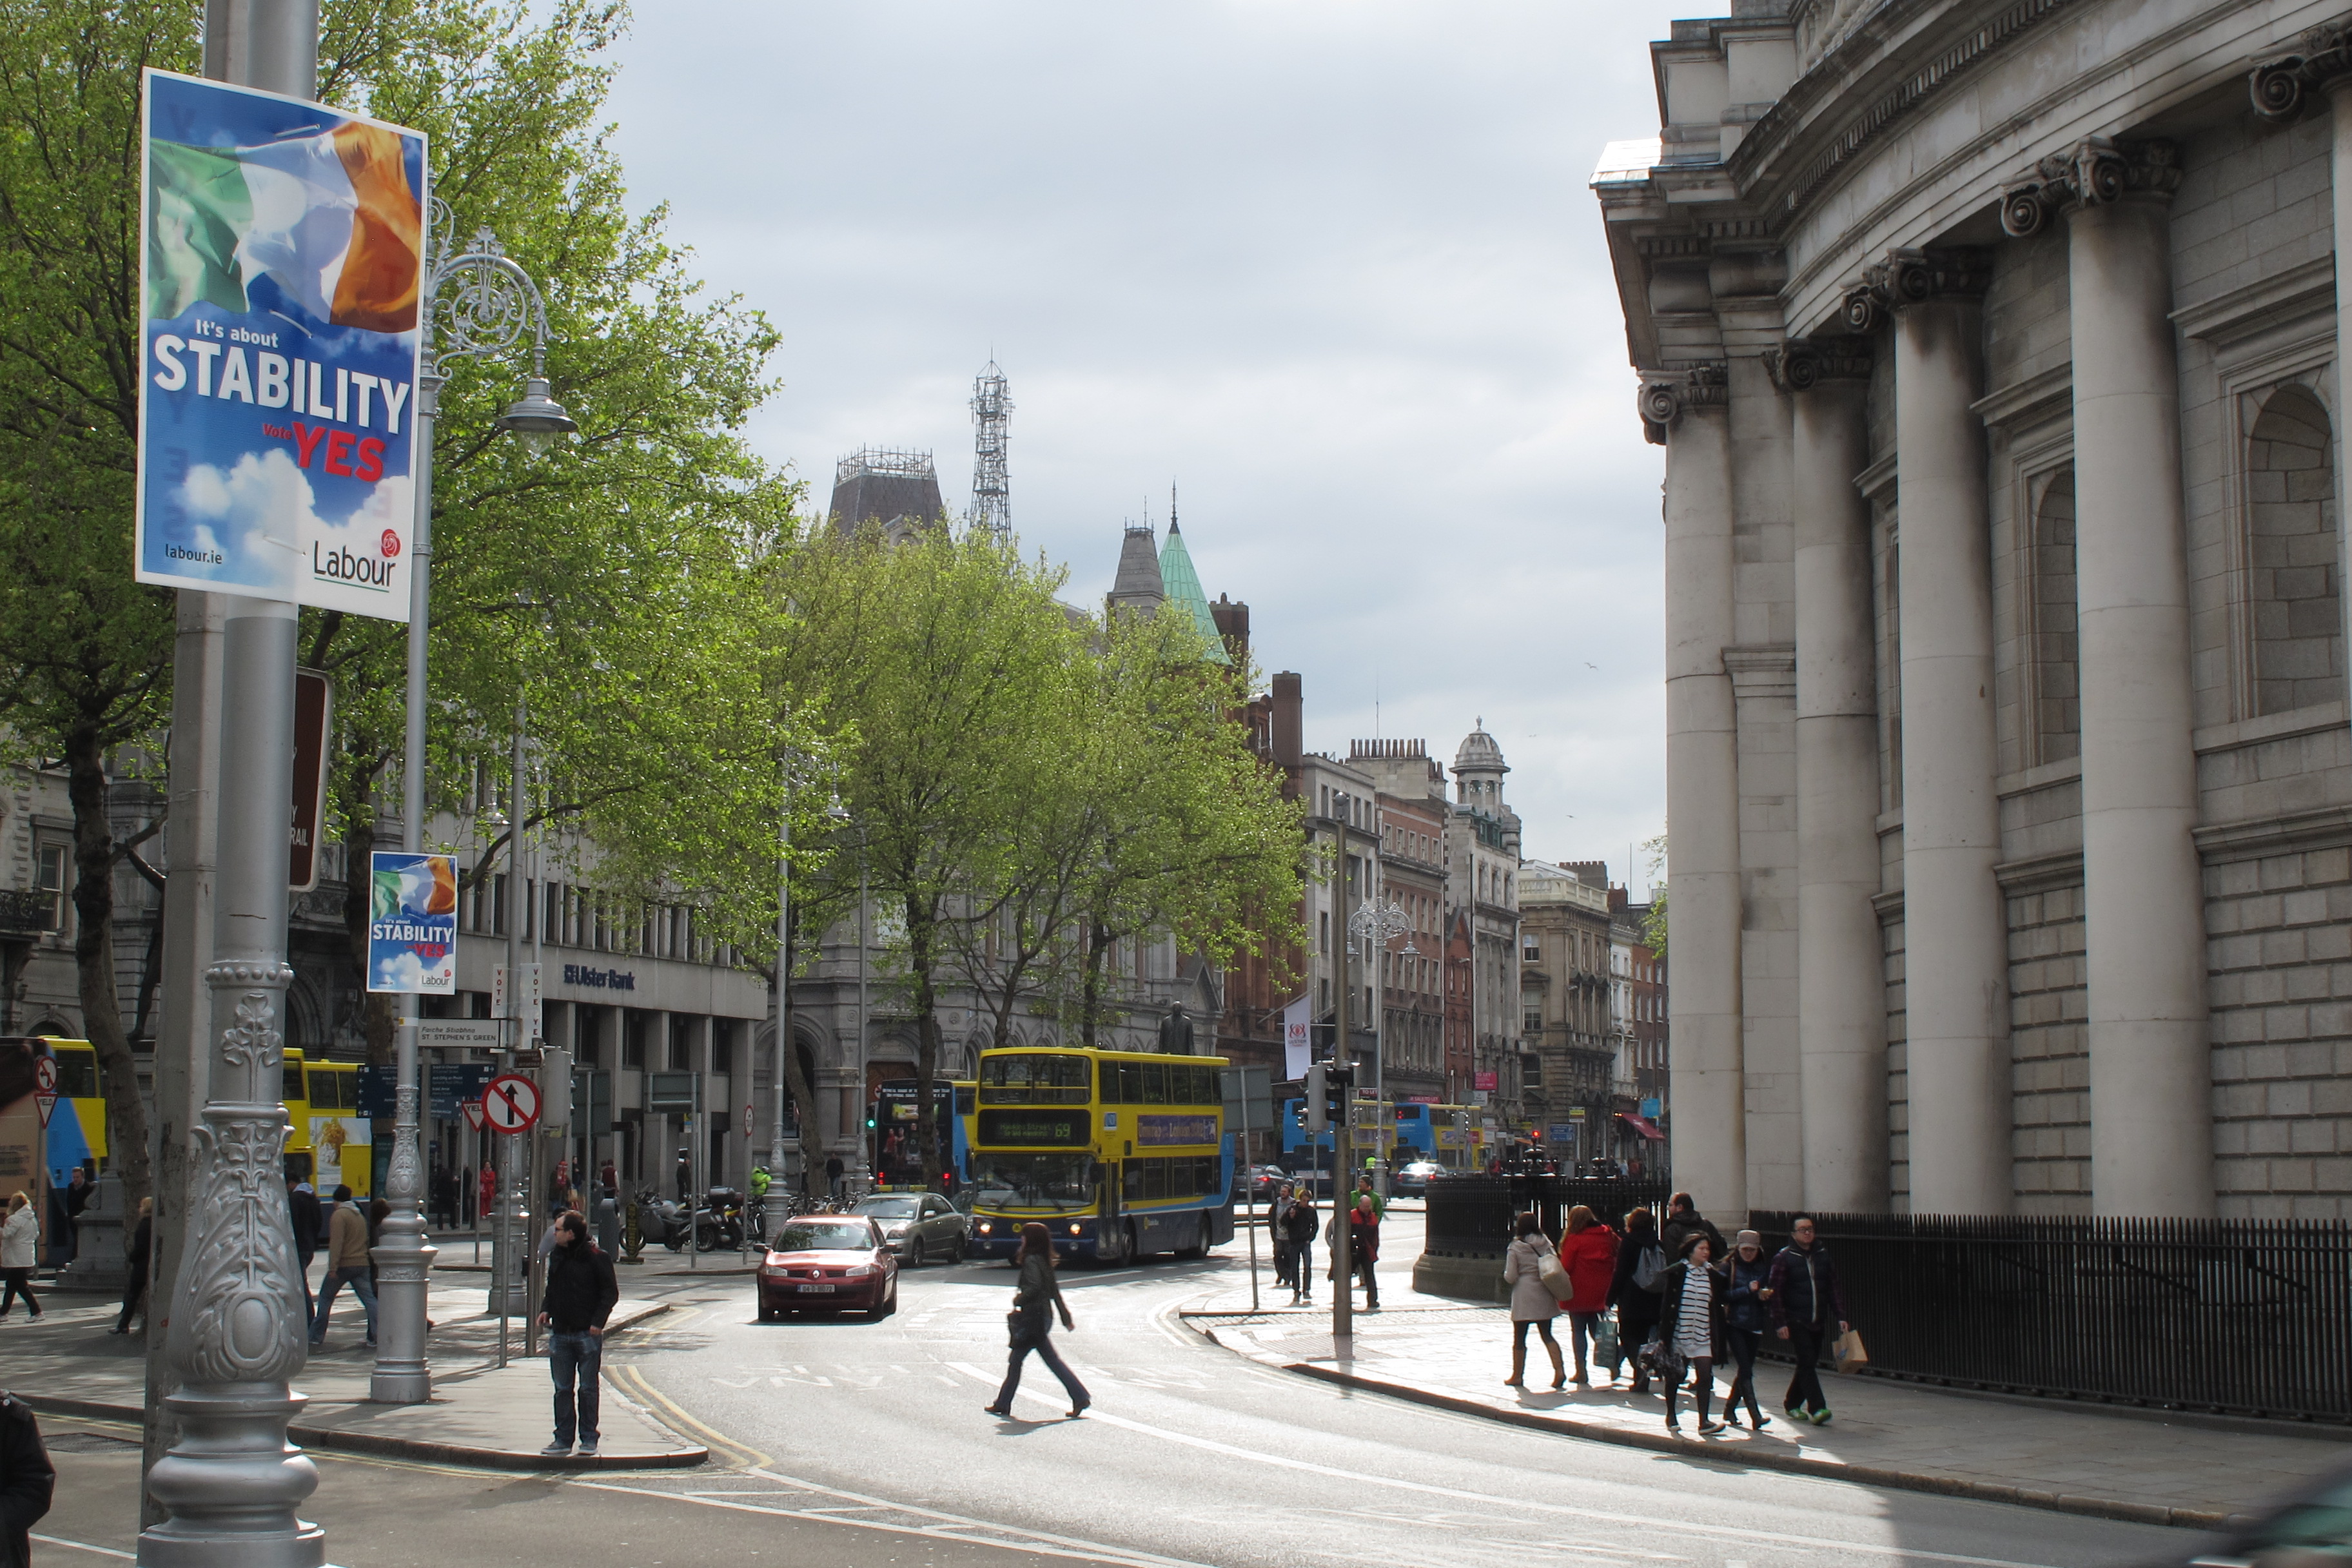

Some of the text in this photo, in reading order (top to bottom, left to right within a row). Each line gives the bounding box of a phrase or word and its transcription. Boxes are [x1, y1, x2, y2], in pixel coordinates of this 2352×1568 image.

[195, 318, 279, 348] It's about
[153, 334, 410, 435] STABILITY
[262, 422, 386, 482] Vote YES
[165, 544, 222, 564] labour.ie
[314, 540, 396, 587] Labour
[290, 827, 309, 847] RAIL
[373, 923, 453, 943] STABILITY
[414, 943, 446, 957] YES
[422, 975, 449, 985] Labour
[576, 965, 636, 991] Ulster Bank
[1055, 1123, 1071, 1137] 69
